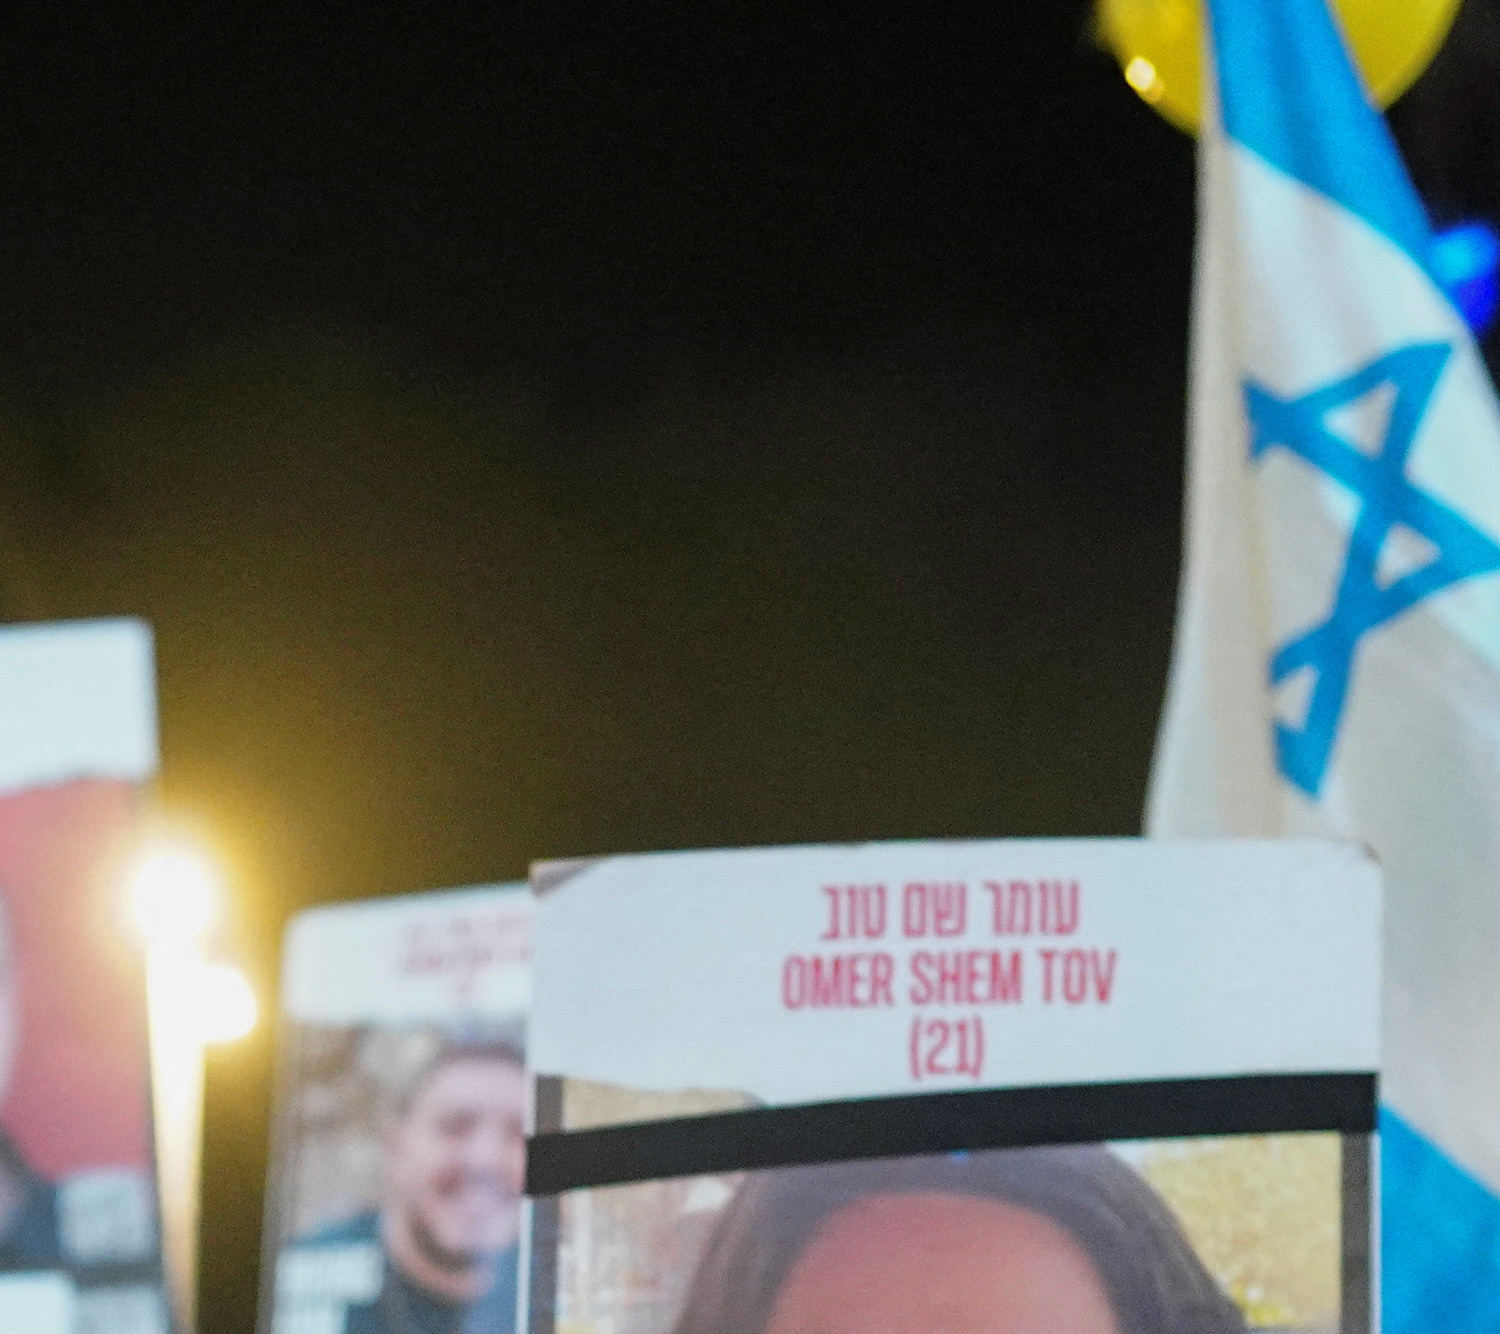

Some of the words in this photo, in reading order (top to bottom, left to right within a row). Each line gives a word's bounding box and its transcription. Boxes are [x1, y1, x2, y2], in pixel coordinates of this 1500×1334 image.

[819, 882, 888, 942] טוב
[902, 879, 967, 939] שם
[983, 879, 1081, 937] עומר
[782, 952, 895, 1011] OMER
[908, 948, 1024, 1006] SHEM
[1036, 947, 1119, 1006] TOV
[908, 1013, 986, 1081] (21)
